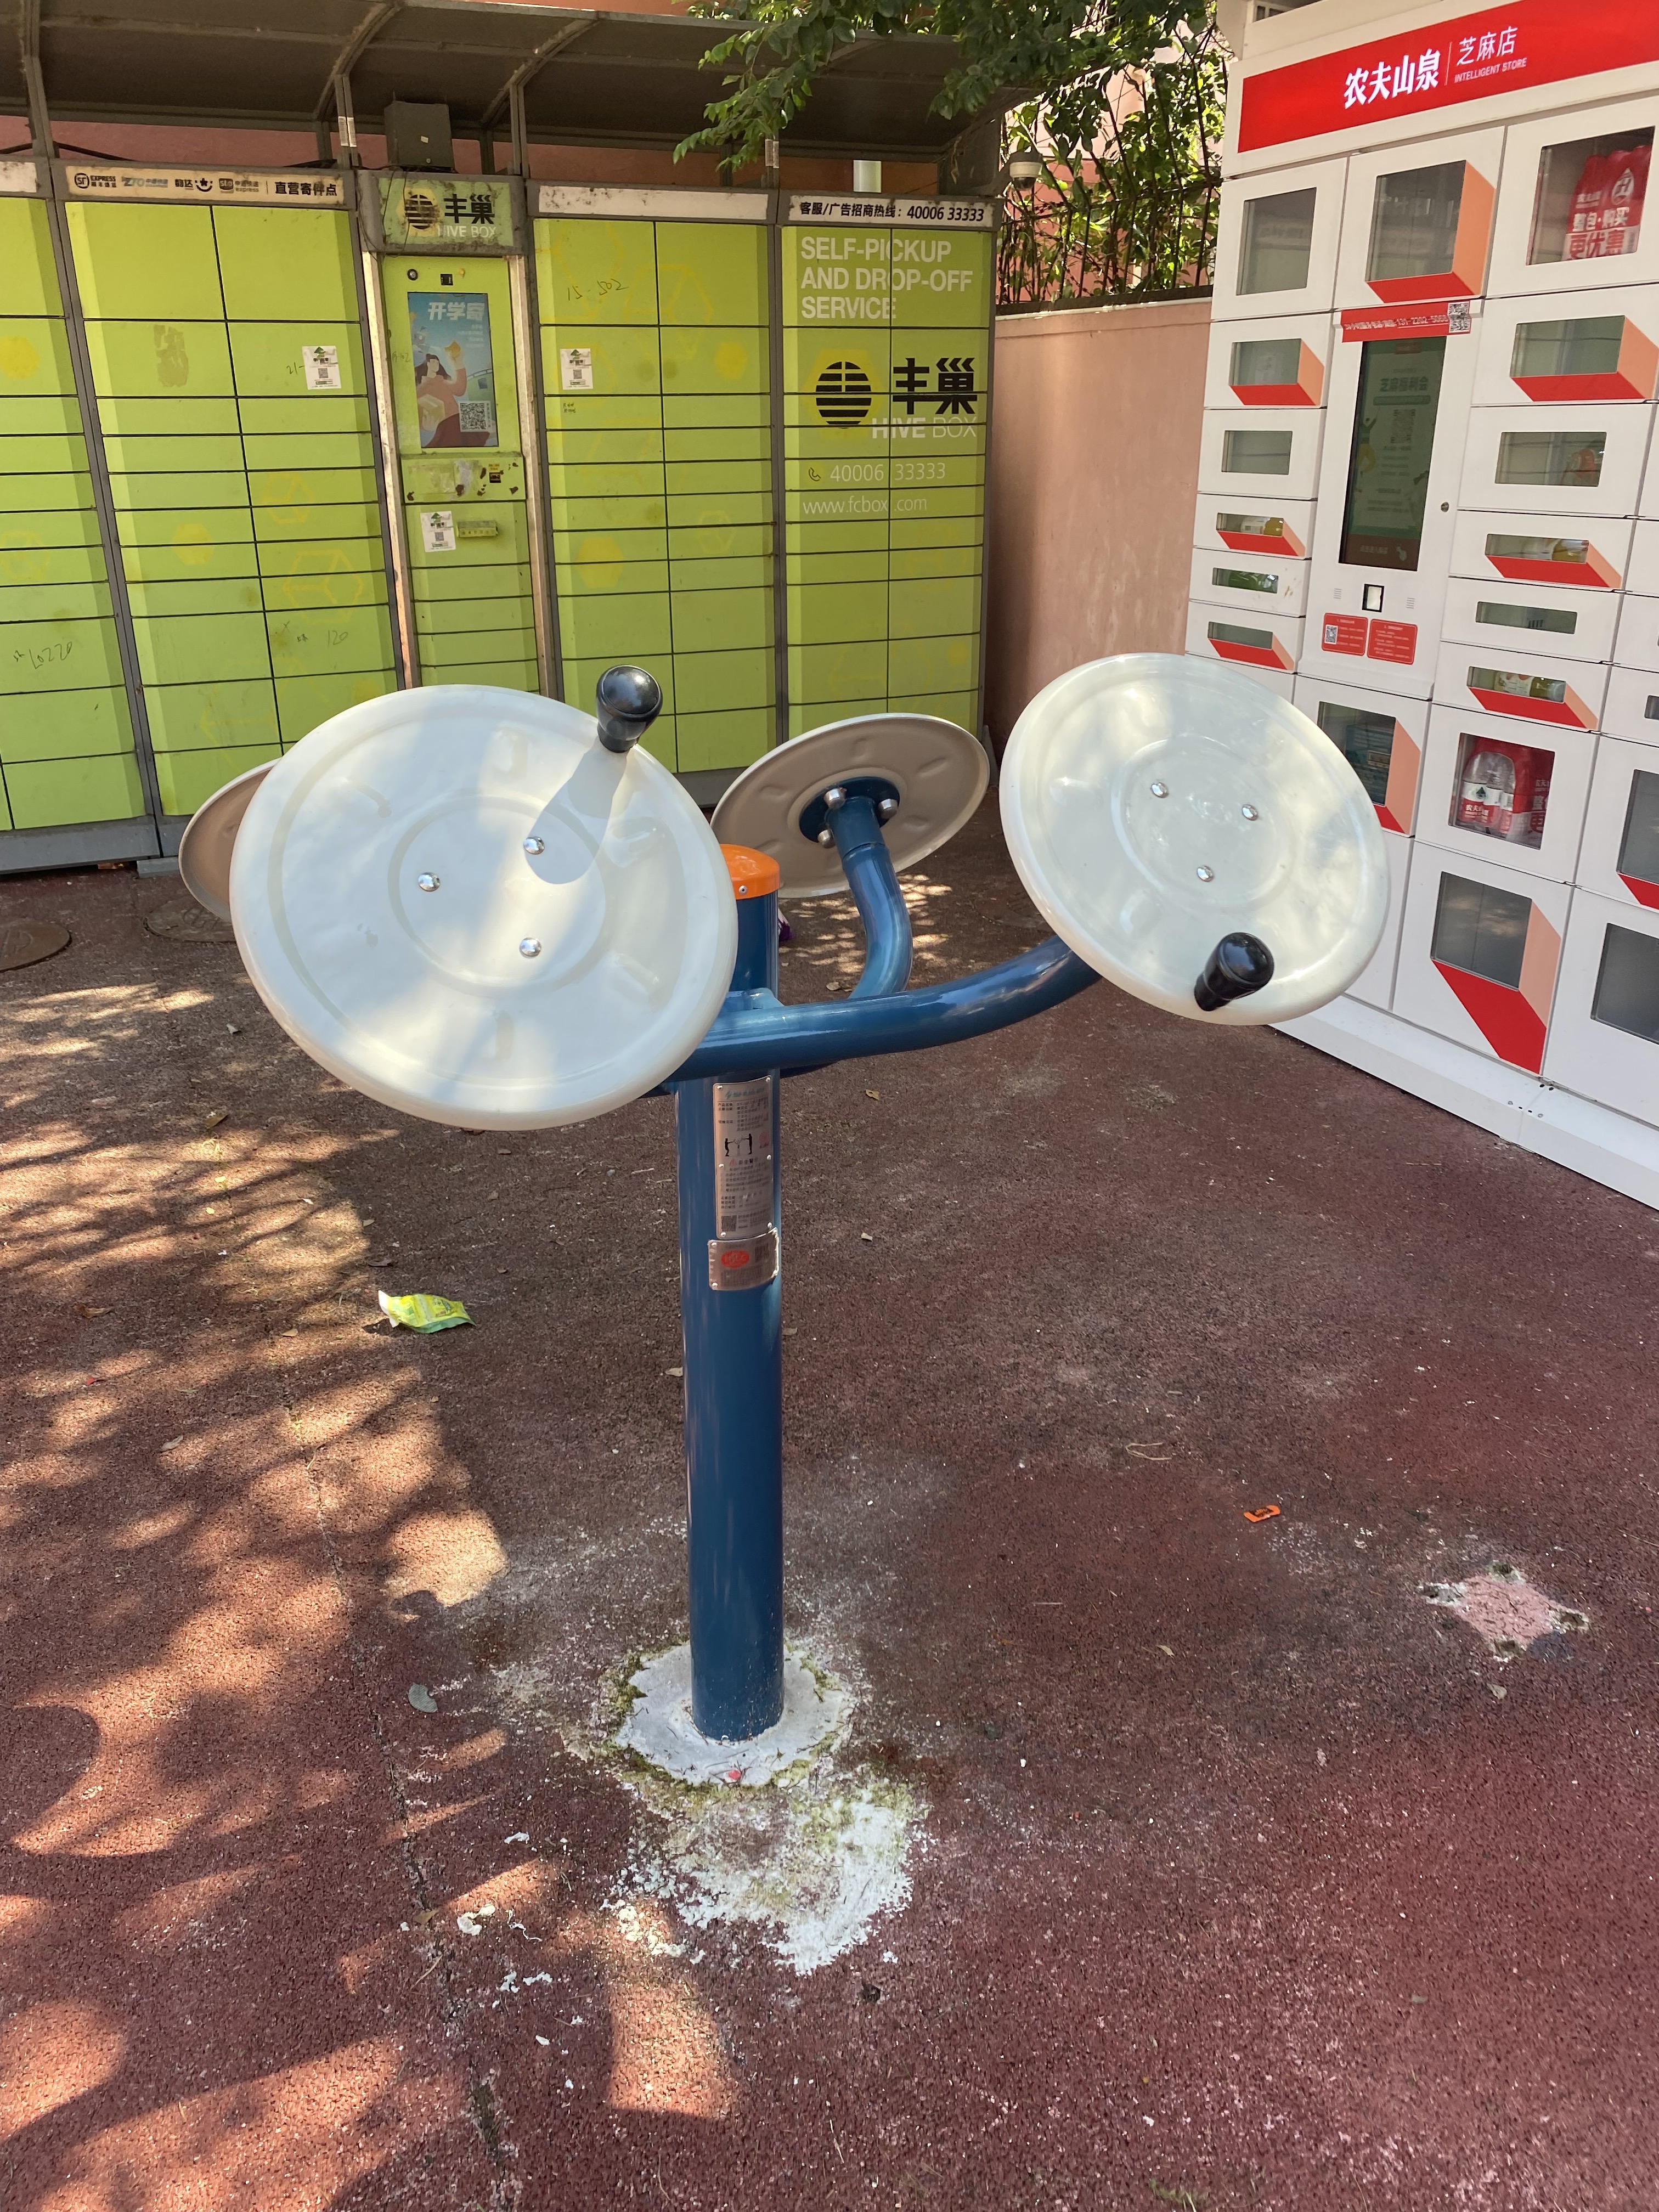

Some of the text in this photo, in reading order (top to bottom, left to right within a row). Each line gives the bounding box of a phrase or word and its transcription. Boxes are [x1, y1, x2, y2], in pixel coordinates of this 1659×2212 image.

[1457, 26, 1518, 66] 芝麻店
[1344, 48, 1441, 110] 农夫山泉
[1454, 57, 1527, 83] INTELLIGENT STORE
[275, 182, 337, 196] 直营寄件点
[443, 194, 495, 224] 丰巢
[907, 206, 944, 220] 40006
[947, 207, 984, 222] 33333
[471, 225, 496, 238] BOX
[800, 236, 952, 263] SELF-PICKUP
[800, 267, 973, 292] AND DROP-OFF
[800, 296, 896, 320] SERVICE
[892, 358, 978, 415] 丰巢
[871, 416, 977, 439] HIVE BOX
[830, 462, 946, 482] 40006 33333
